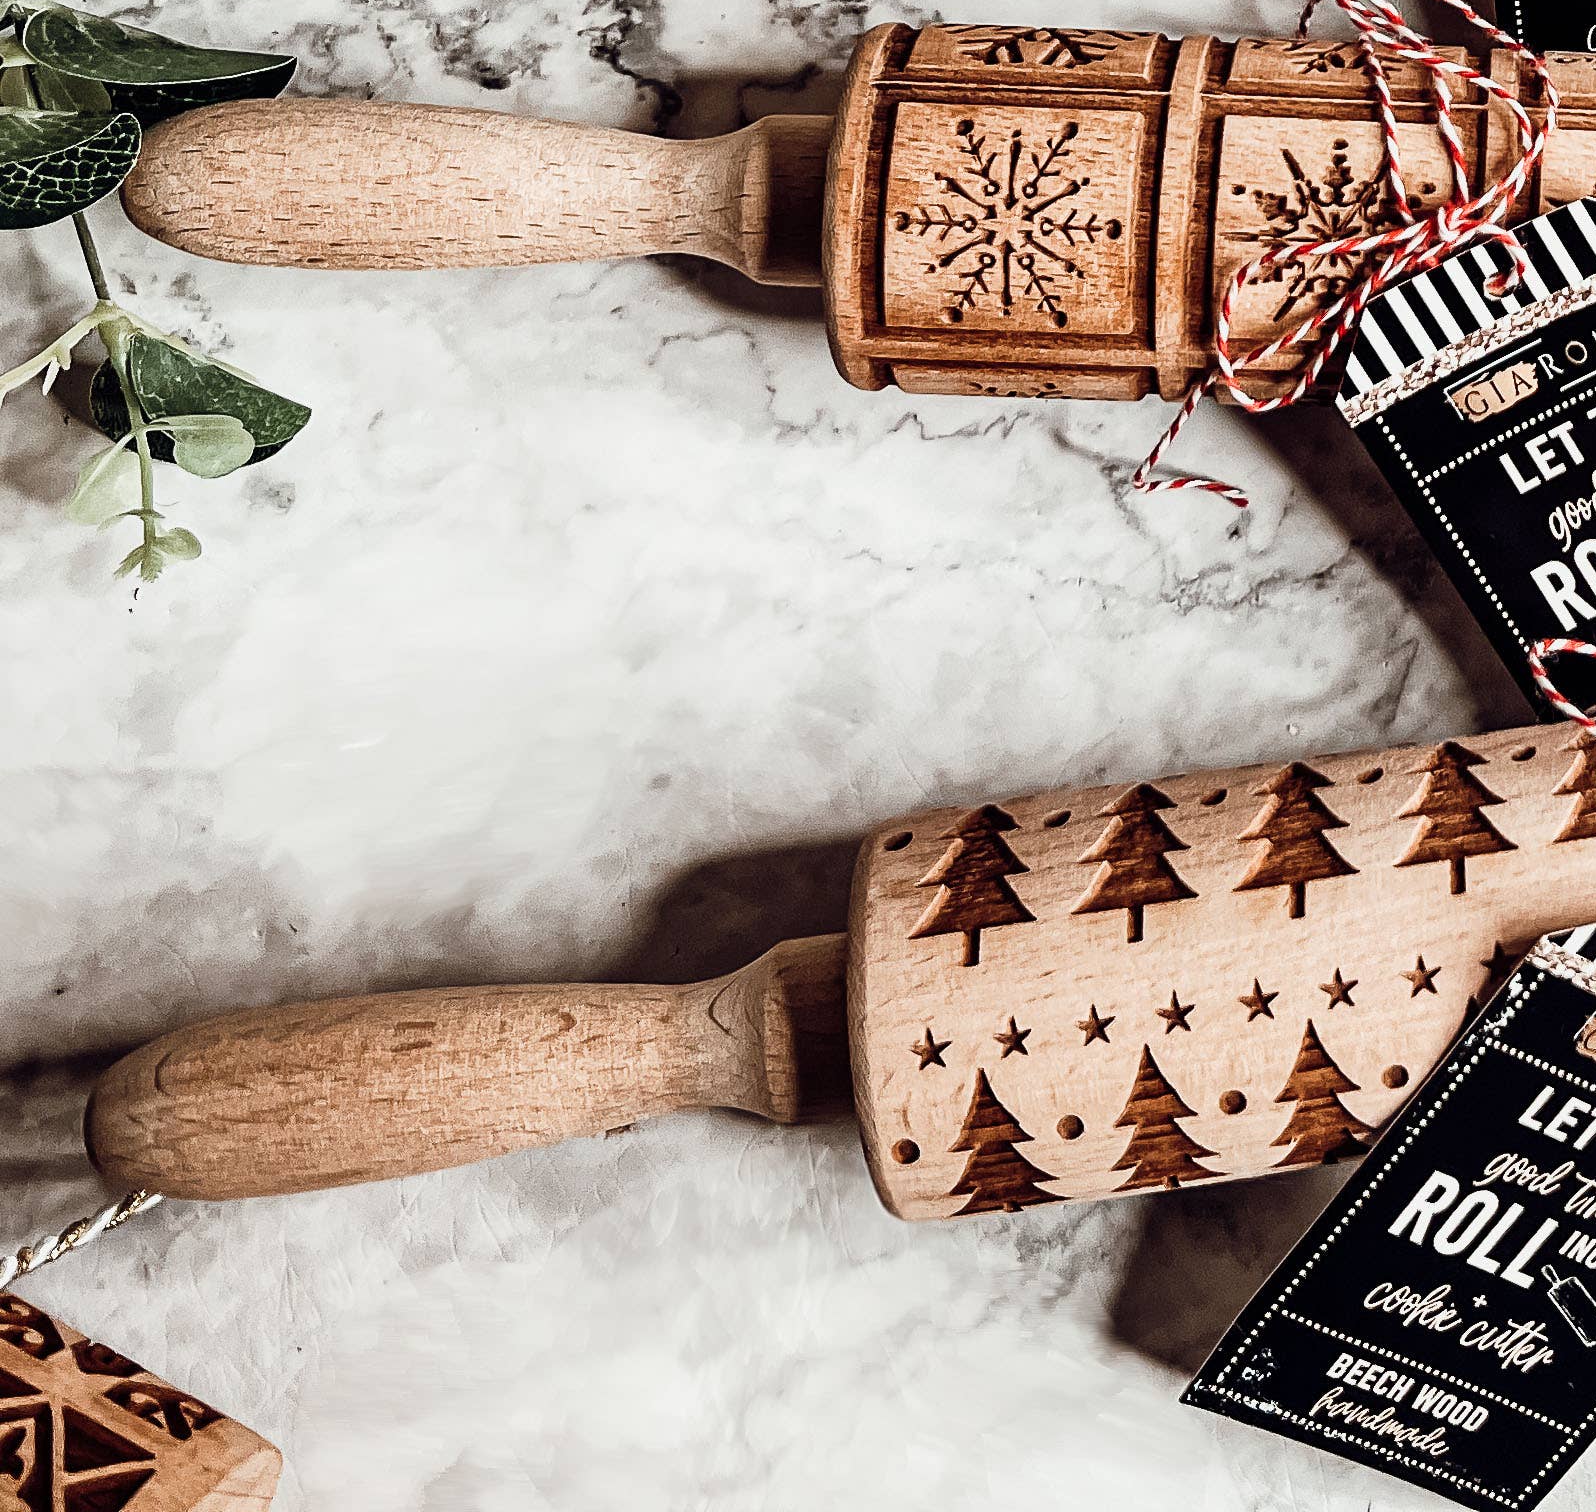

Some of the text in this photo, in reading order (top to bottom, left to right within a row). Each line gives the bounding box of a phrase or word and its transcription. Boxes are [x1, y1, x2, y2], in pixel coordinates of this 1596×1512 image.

[1499, 420, 1586, 495] LET
[1474, 1150, 1575, 1197] good
[1388, 1169, 1560, 1291] ROLL
[1363, 1279, 1557, 1373] cookie cutter
[1309, 1386, 1450, 1457] handmade
[1326, 1352, 1490, 1433] BEECH WOOD
